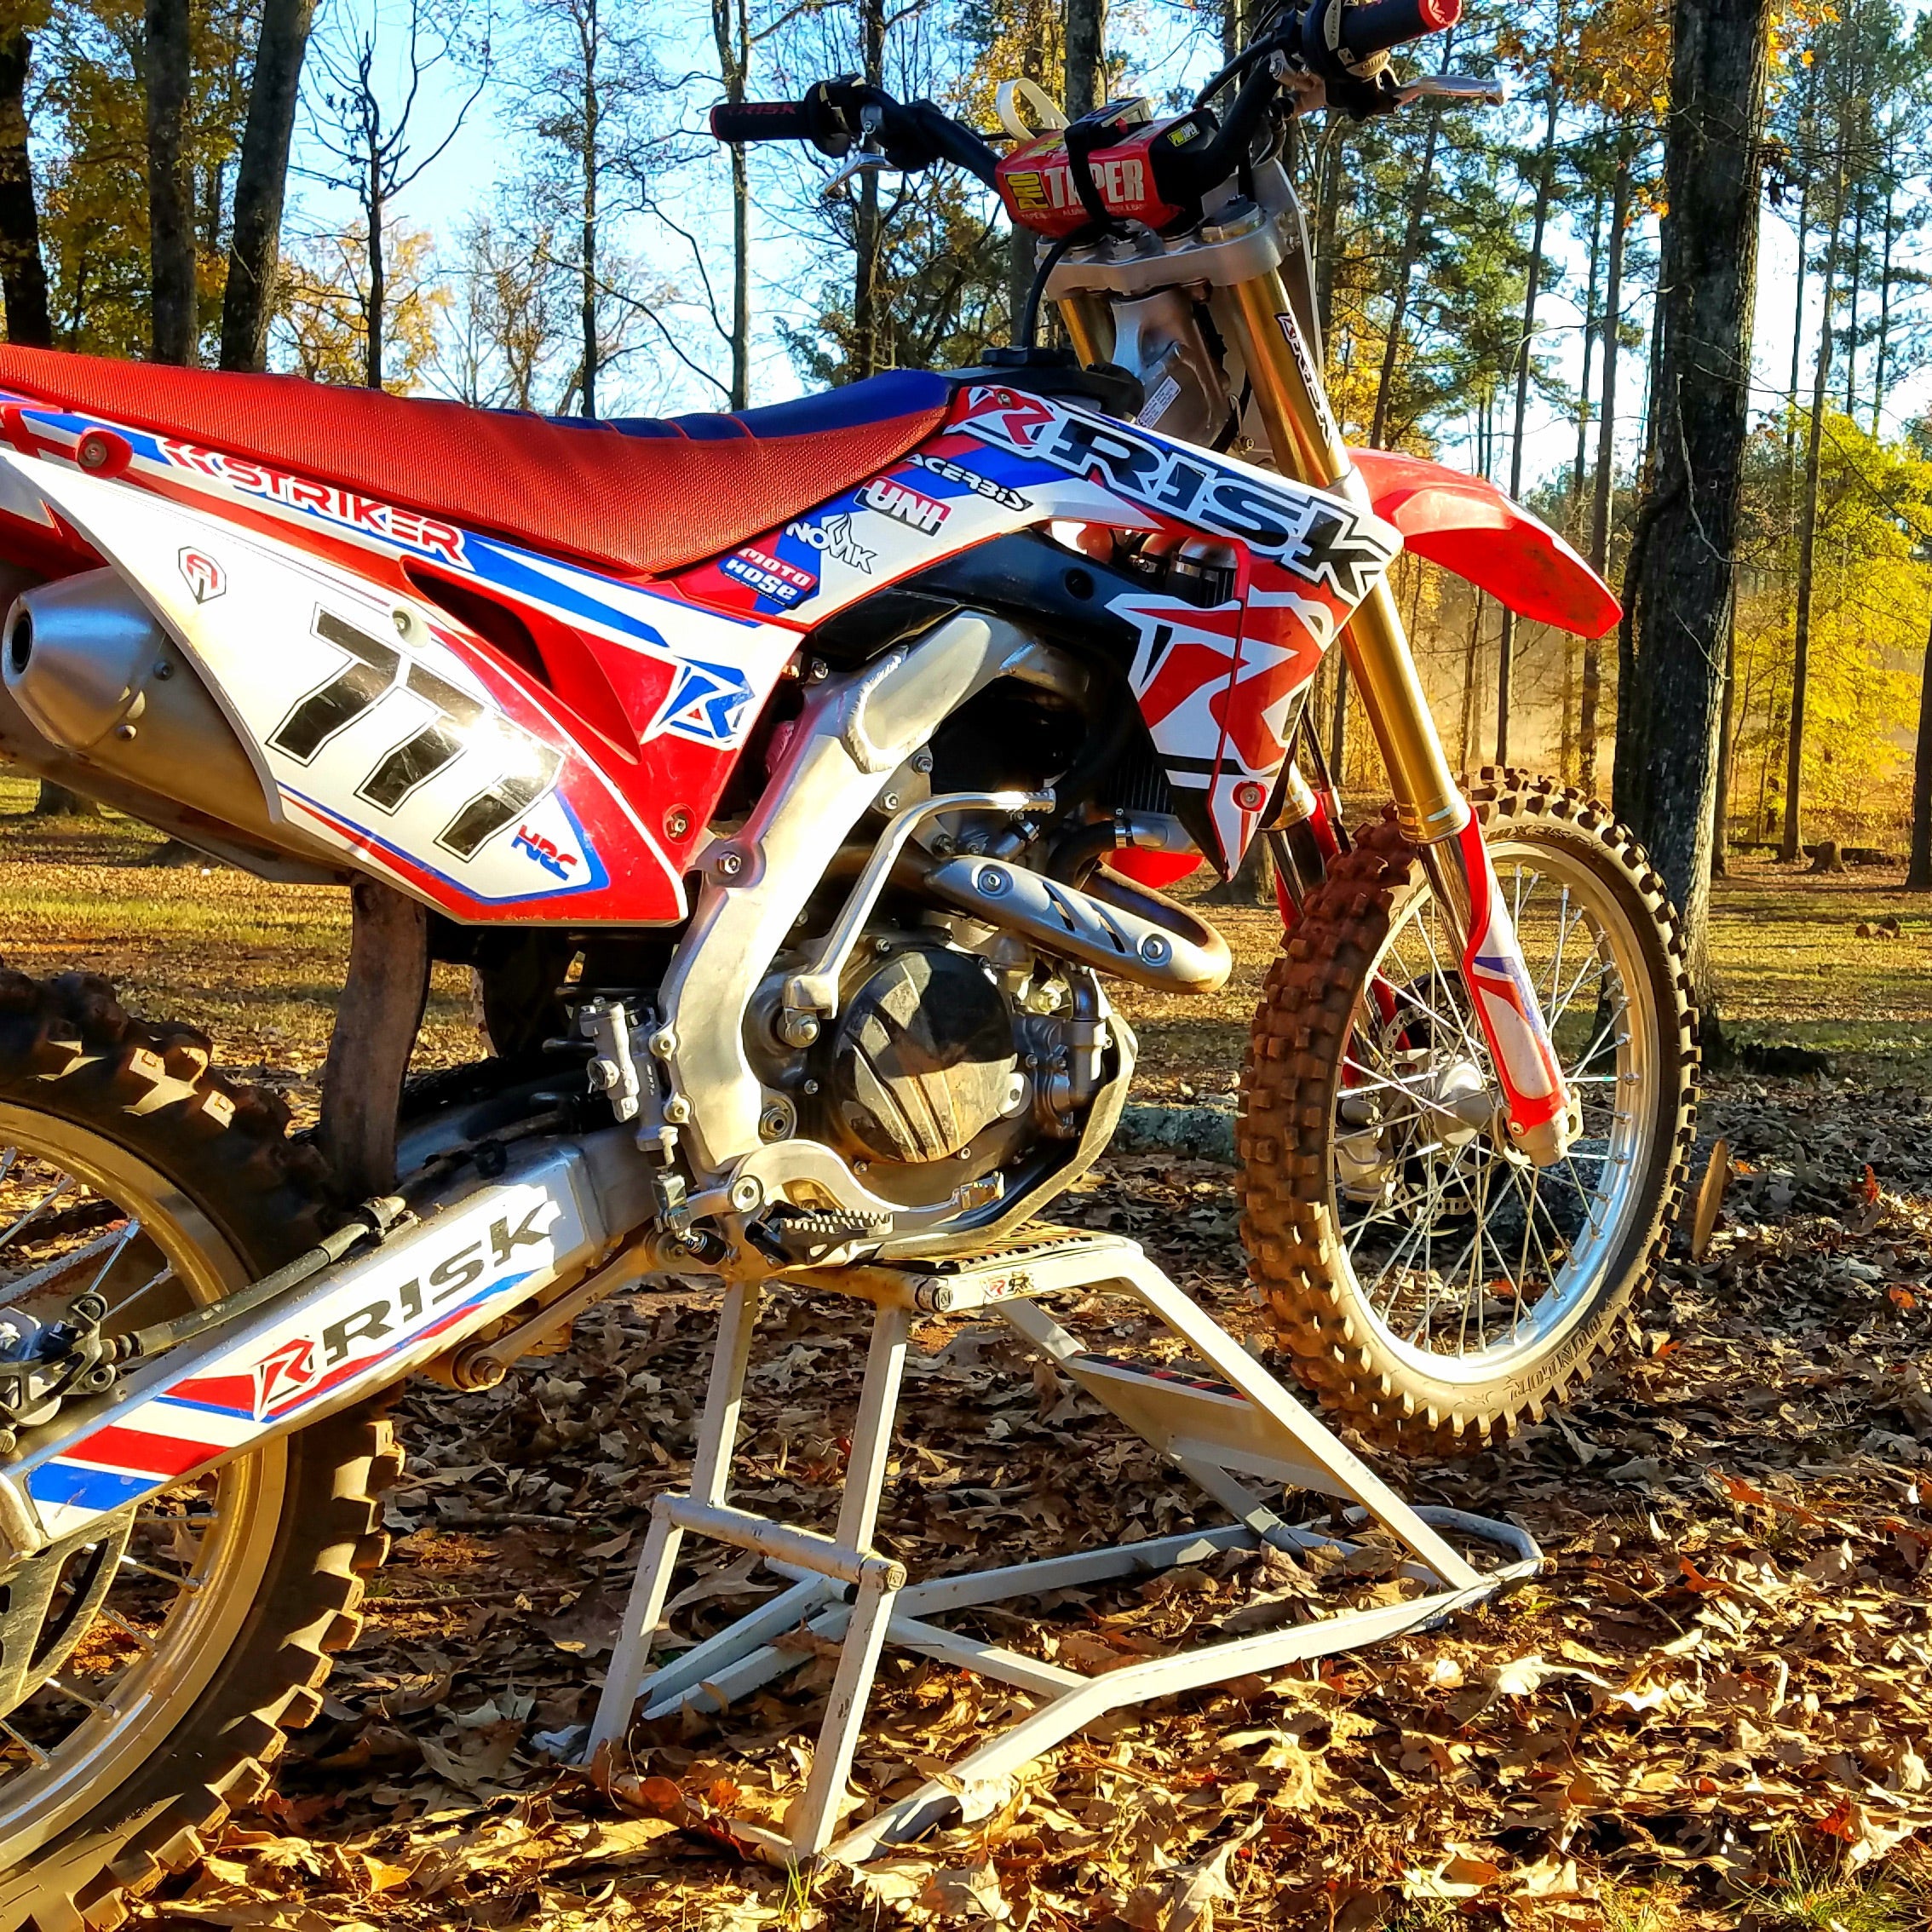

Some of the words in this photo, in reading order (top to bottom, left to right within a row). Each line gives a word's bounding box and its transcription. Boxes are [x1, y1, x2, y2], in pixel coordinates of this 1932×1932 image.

[1007, 173, 1050, 211] PRO
[222, 457, 461, 561] STRIKER
[865, 480, 947, 532] UNI
[900, 454, 1029, 510] ACERBIS
[1049, 417, 1383, 602] RISK
[736, 548, 811, 585] MOTO
[511, 824, 577, 881] HRC
[322, 1202, 552, 1365] RISK
[1511, 1314, 1606, 1401] DUNLOP
